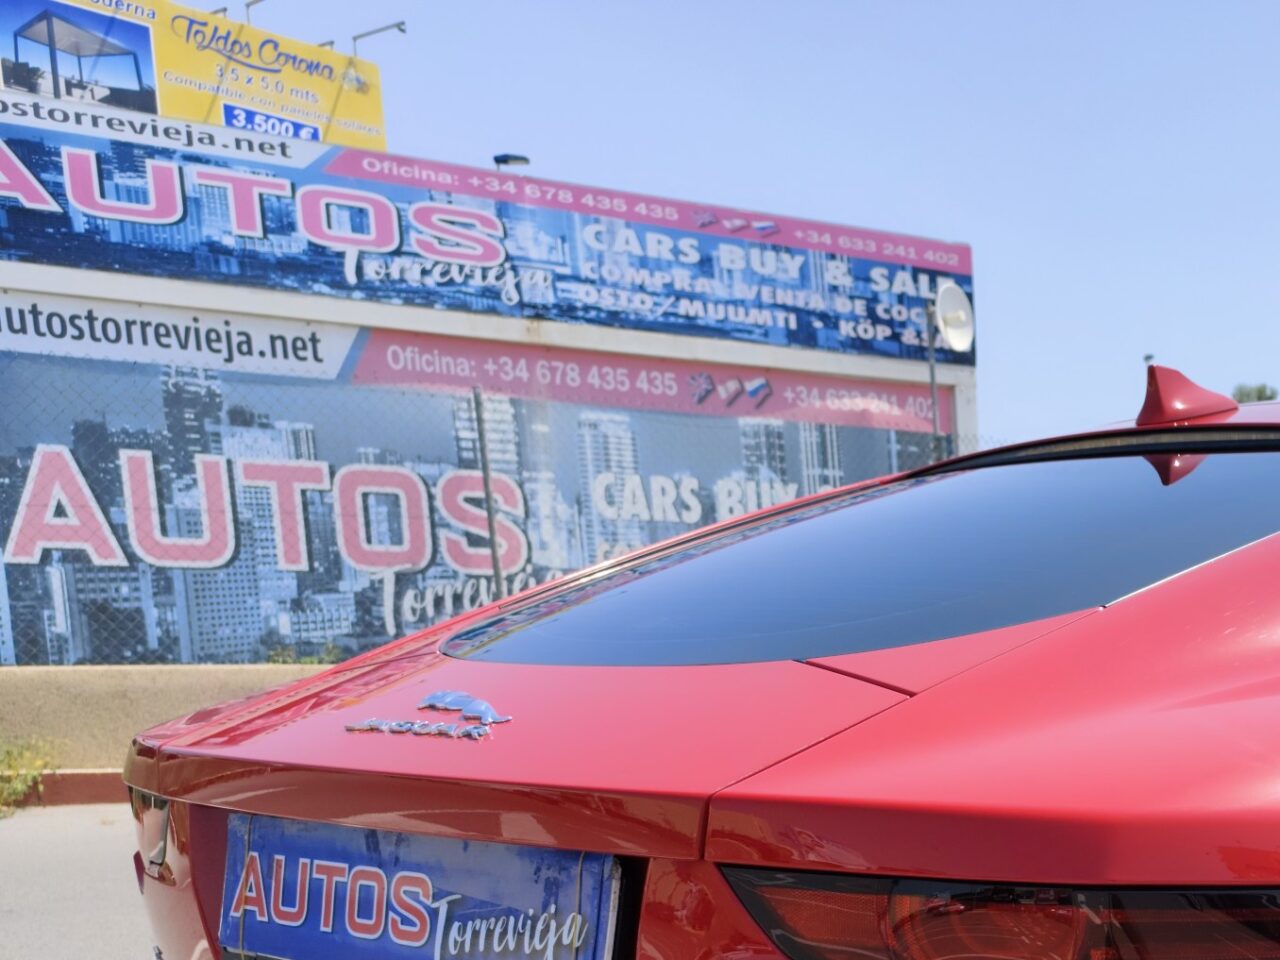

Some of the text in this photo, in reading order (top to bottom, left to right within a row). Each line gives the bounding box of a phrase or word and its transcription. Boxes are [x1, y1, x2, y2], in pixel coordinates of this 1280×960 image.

[171, 15, 337, 82] Toldos Corona
[163, 71, 246, 101] Compatible
[232, 108, 295, 137] 3.500
[361, 156, 679, 222] Oficina: +34 678 435 435
[583, 222, 701, 265] CARS
[717, 241, 807, 281] BUY
[826, 261, 854, 288] &
[793, 228, 960, 266] +34 633 241 402
[836, 294, 868, 317] DE
[838, 317, 893, 342] KÖP
[0, 302, 324, 364] utostorrevieja.net
[386, 344, 679, 397] Oficina: +34 678 435 435
[3, 443, 530, 576] AUTOS
[592, 471, 702, 525] CARS
[229, 850, 434, 948] AUTOS
